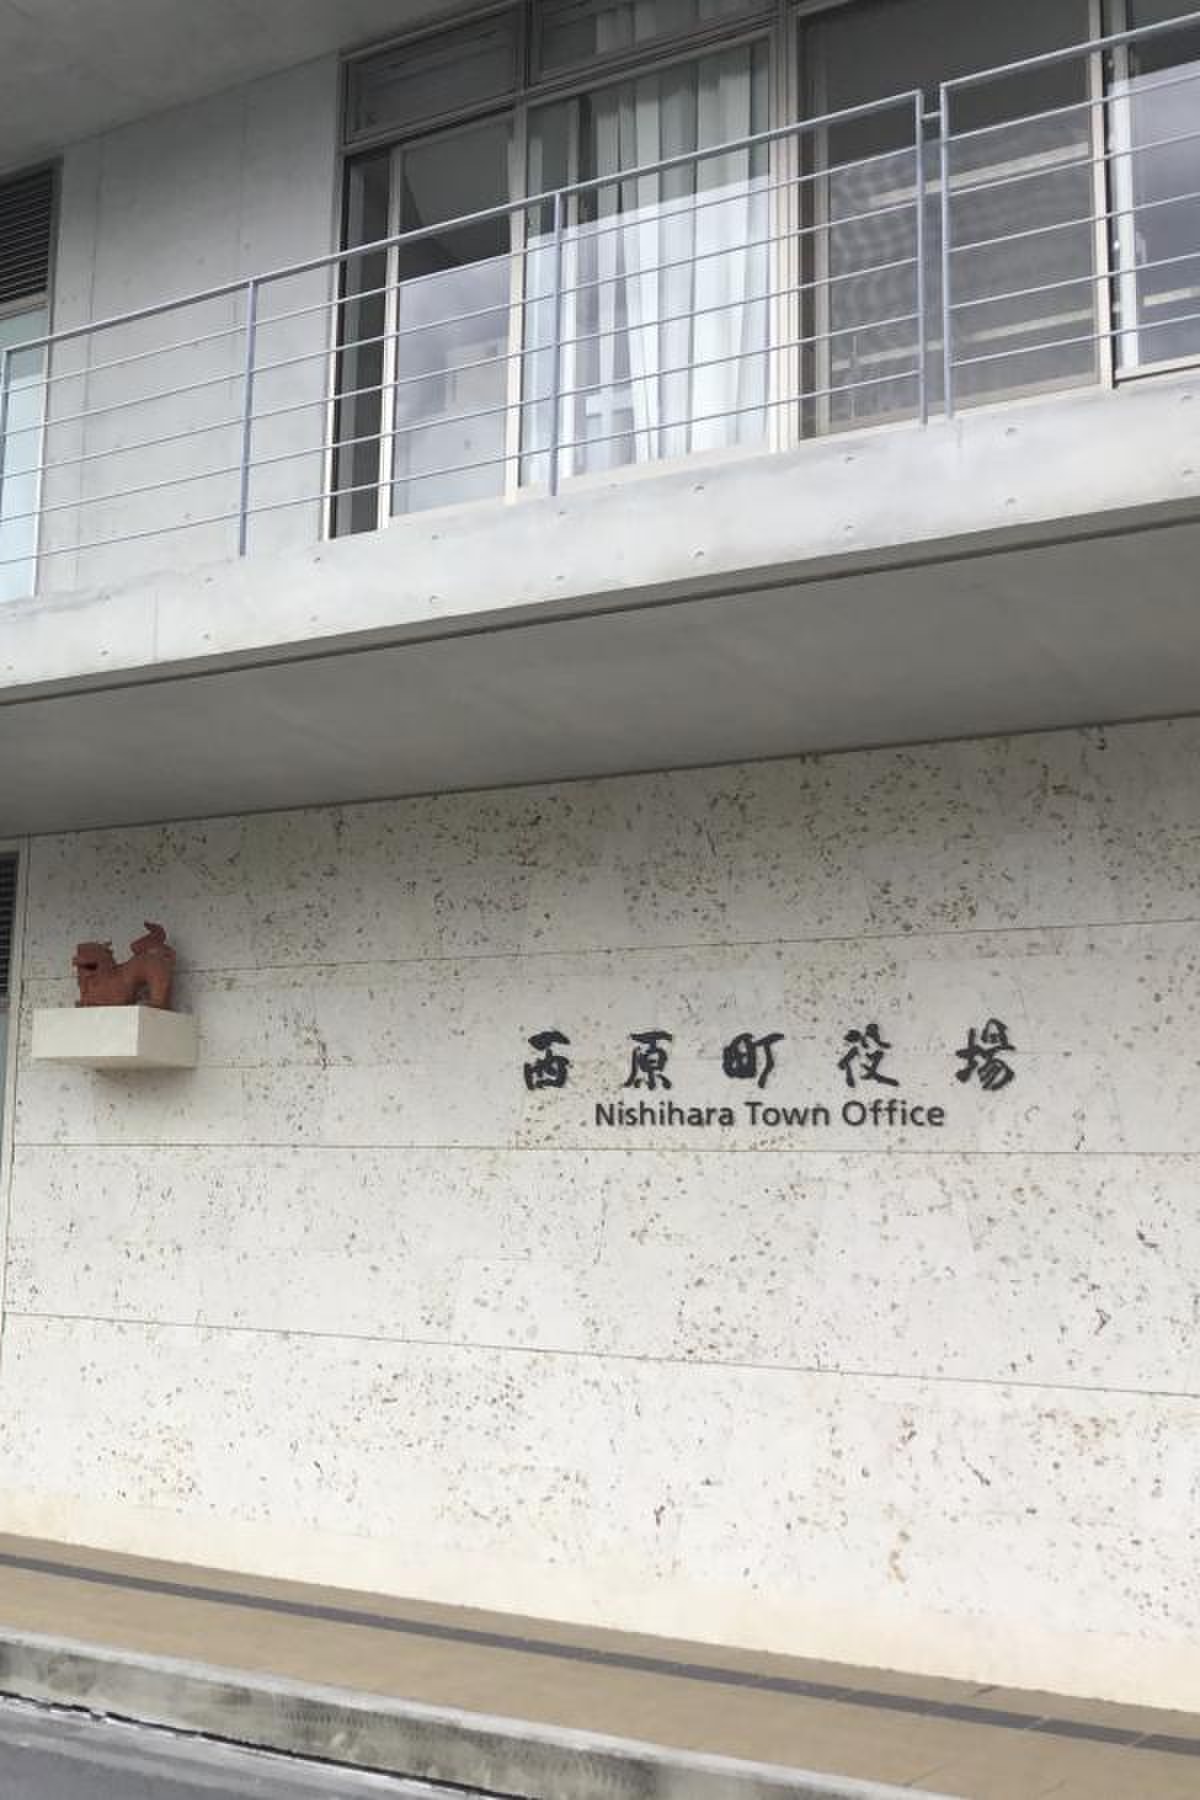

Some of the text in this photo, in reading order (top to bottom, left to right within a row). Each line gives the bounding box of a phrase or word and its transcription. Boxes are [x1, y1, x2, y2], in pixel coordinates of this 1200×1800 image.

[523, 1017, 1016, 1092] 西原町役場
[594, 1099, 946, 1128] Nishihara Town Office
